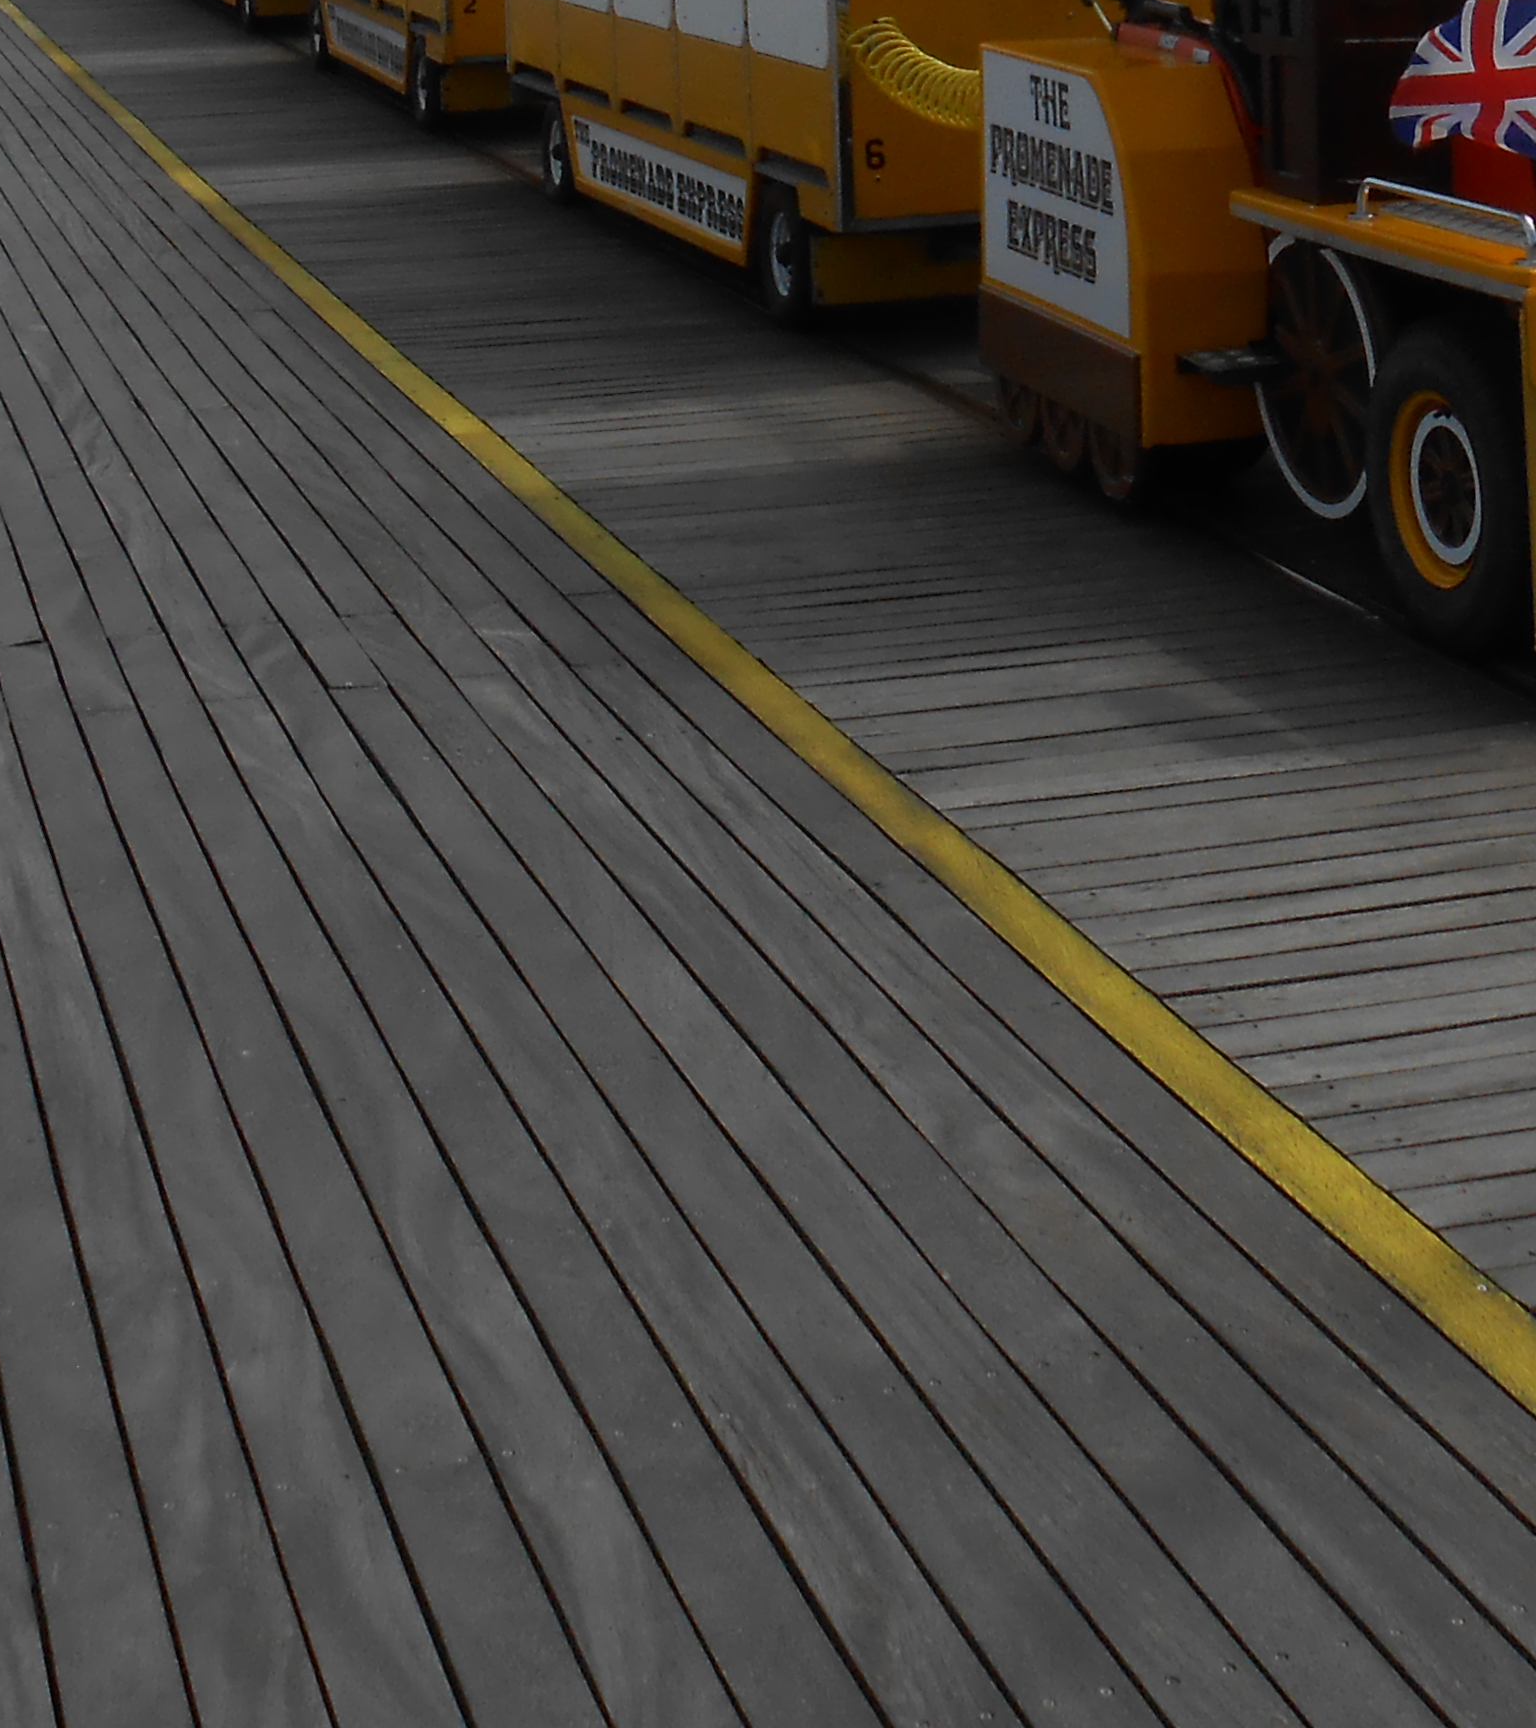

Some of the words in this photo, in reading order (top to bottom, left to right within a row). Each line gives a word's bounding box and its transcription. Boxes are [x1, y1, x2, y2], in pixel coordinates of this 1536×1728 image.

[1029, 75, 1071, 130] THE
[865, 138, 886, 170] 6
[989, 124, 1115, 216] PROMENADE
[1007, 200, 1098, 284] EXPRESS
